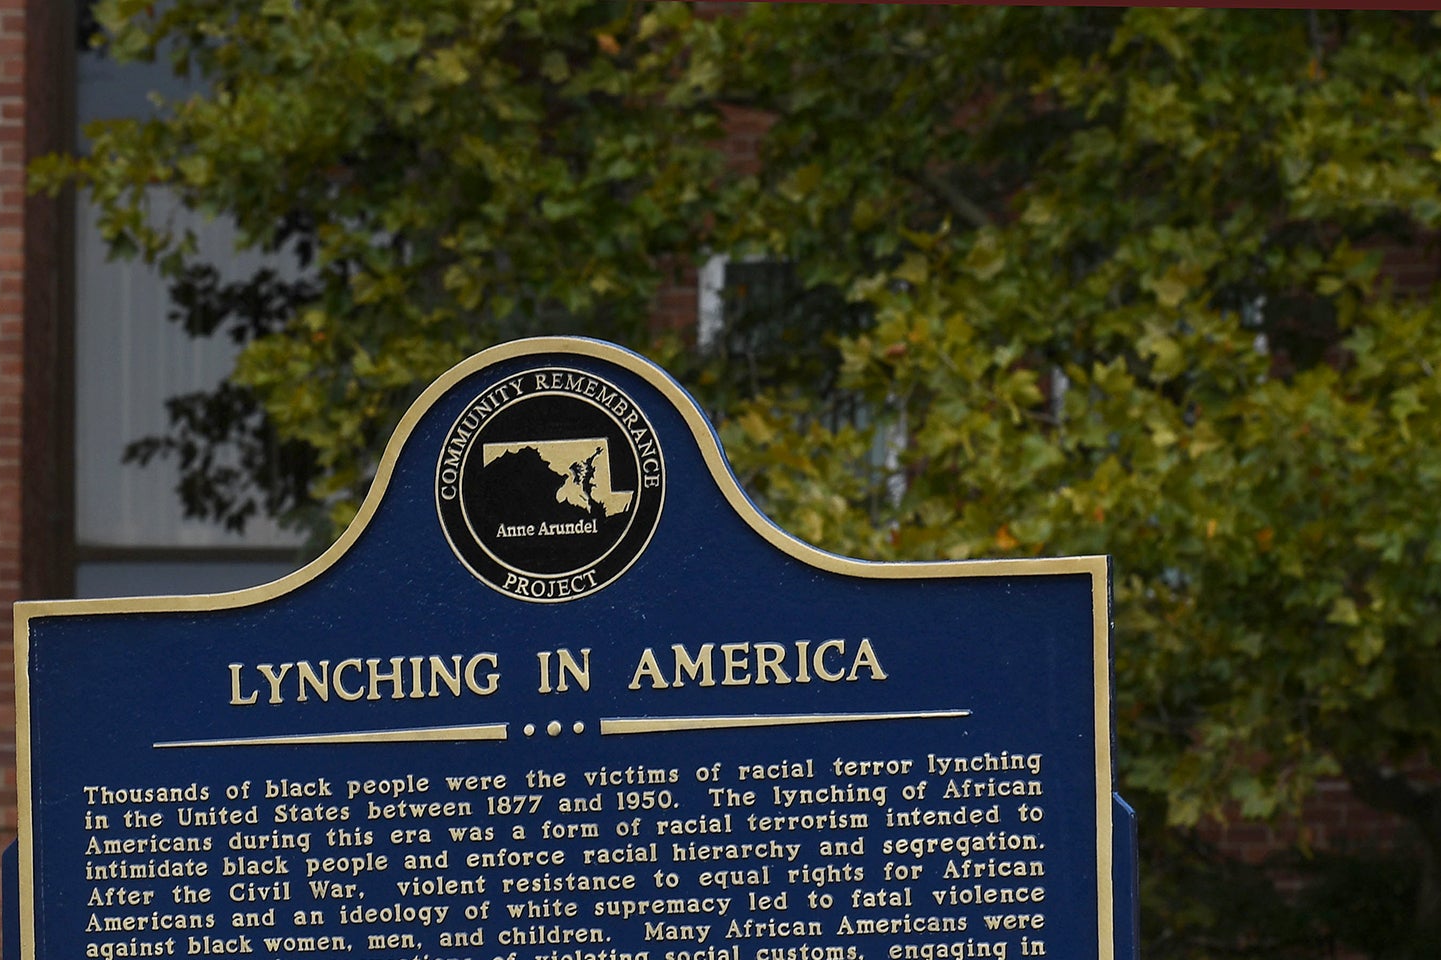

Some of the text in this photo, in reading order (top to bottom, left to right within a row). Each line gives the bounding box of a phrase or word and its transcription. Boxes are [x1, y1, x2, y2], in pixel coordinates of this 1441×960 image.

[441, 372, 660, 500] COMMUNITY REMEMBRANCE
[496, 518, 598, 538] Anne Arundel
[502, 569, 599, 598] PROJECT
[226, 638, 889, 707] LYNCHING IN AMERICA
[83, 753, 1041, 804] Thousands of black people were the victims of racial terror lynching
[85, 777, 1043, 829] in the United States between 1877 and 1950. The lynching of African
[87, 857, 1044, 906] After the Civil War, violent resistance to equal rights for African
[187, 934, 252, 954] black
[263, 936, 351, 951] women,
[367, 933, 421, 949] men,
[439, 927, 483, 946] and
[498, 925, 610, 944] children.
[644, 921, 710, 943] Many
[725, 918, 822, 938] African
[836, 913, 966, 934] Americans
[983, 913, 1044, 929] were
